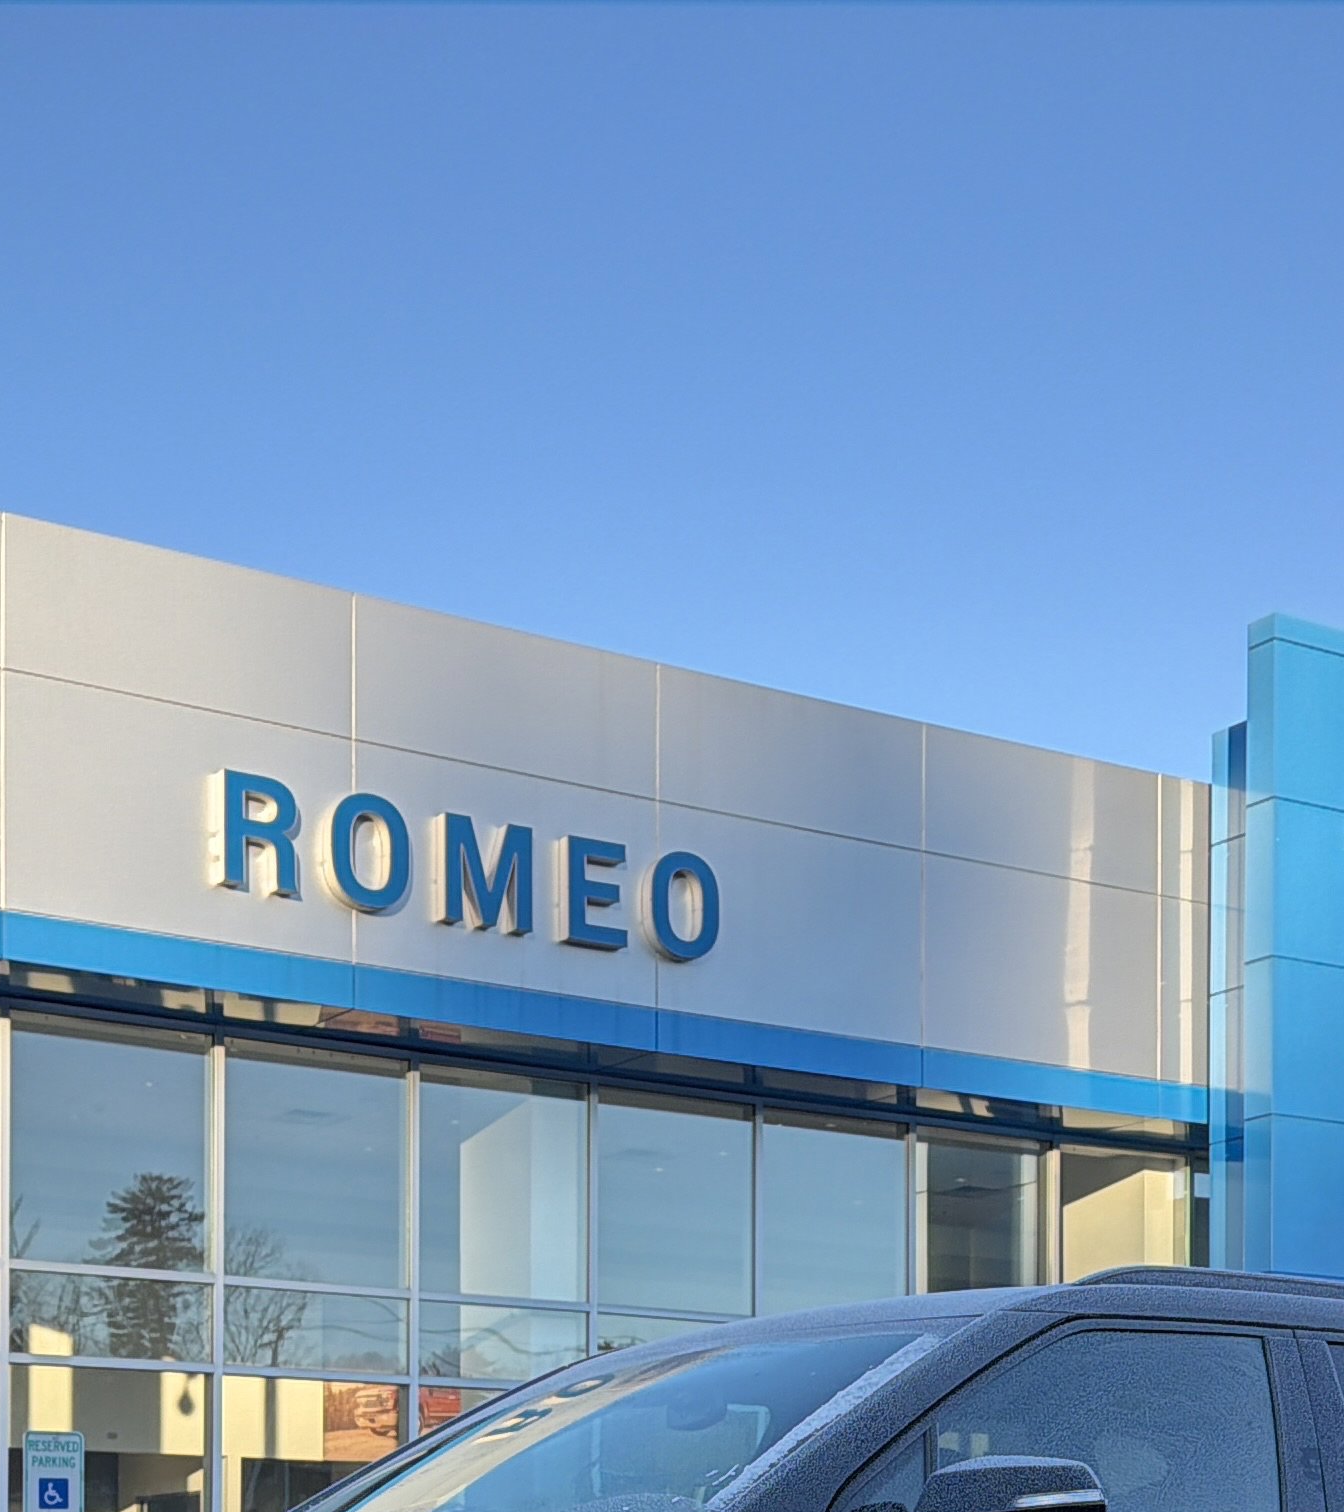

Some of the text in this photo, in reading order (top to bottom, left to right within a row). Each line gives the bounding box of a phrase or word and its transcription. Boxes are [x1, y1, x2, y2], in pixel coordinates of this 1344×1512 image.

[210, 768, 720, 962] ROMEO
[27, 1439, 79, 1452] RESERVED
[31, 1455, 76, 1468] PARKING
